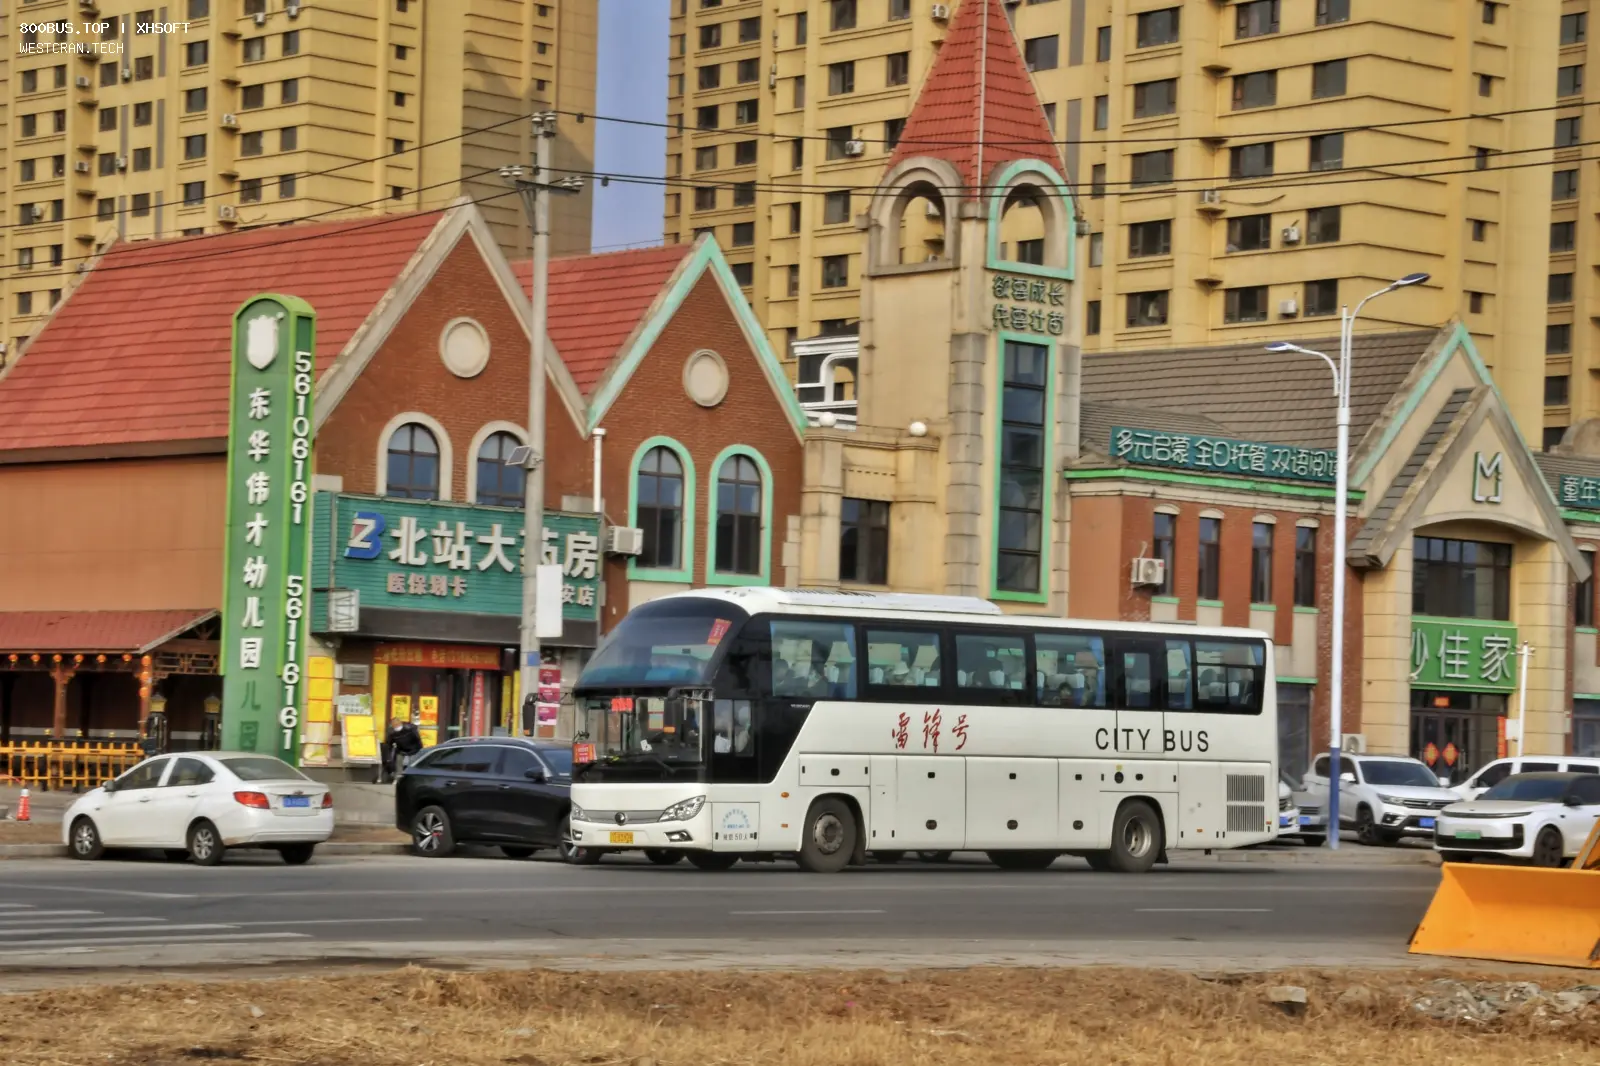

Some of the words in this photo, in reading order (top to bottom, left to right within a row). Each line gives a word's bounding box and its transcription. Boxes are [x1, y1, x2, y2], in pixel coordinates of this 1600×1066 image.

[290, 351, 311, 524] 56106161
[1116, 429, 1190, 464] 多元启蒙
[1194, 438, 1268, 472] 全日托管
[1563, 476, 1600, 504] 童年
[240, 387, 272, 669] 东华伟才幼儿园
[279, 575, 304, 750] 56116161
[892, 708, 969, 753] 雷锋号
[1095, 728, 1151, 751] CITY
[1164, 730, 1209, 752] BUS
